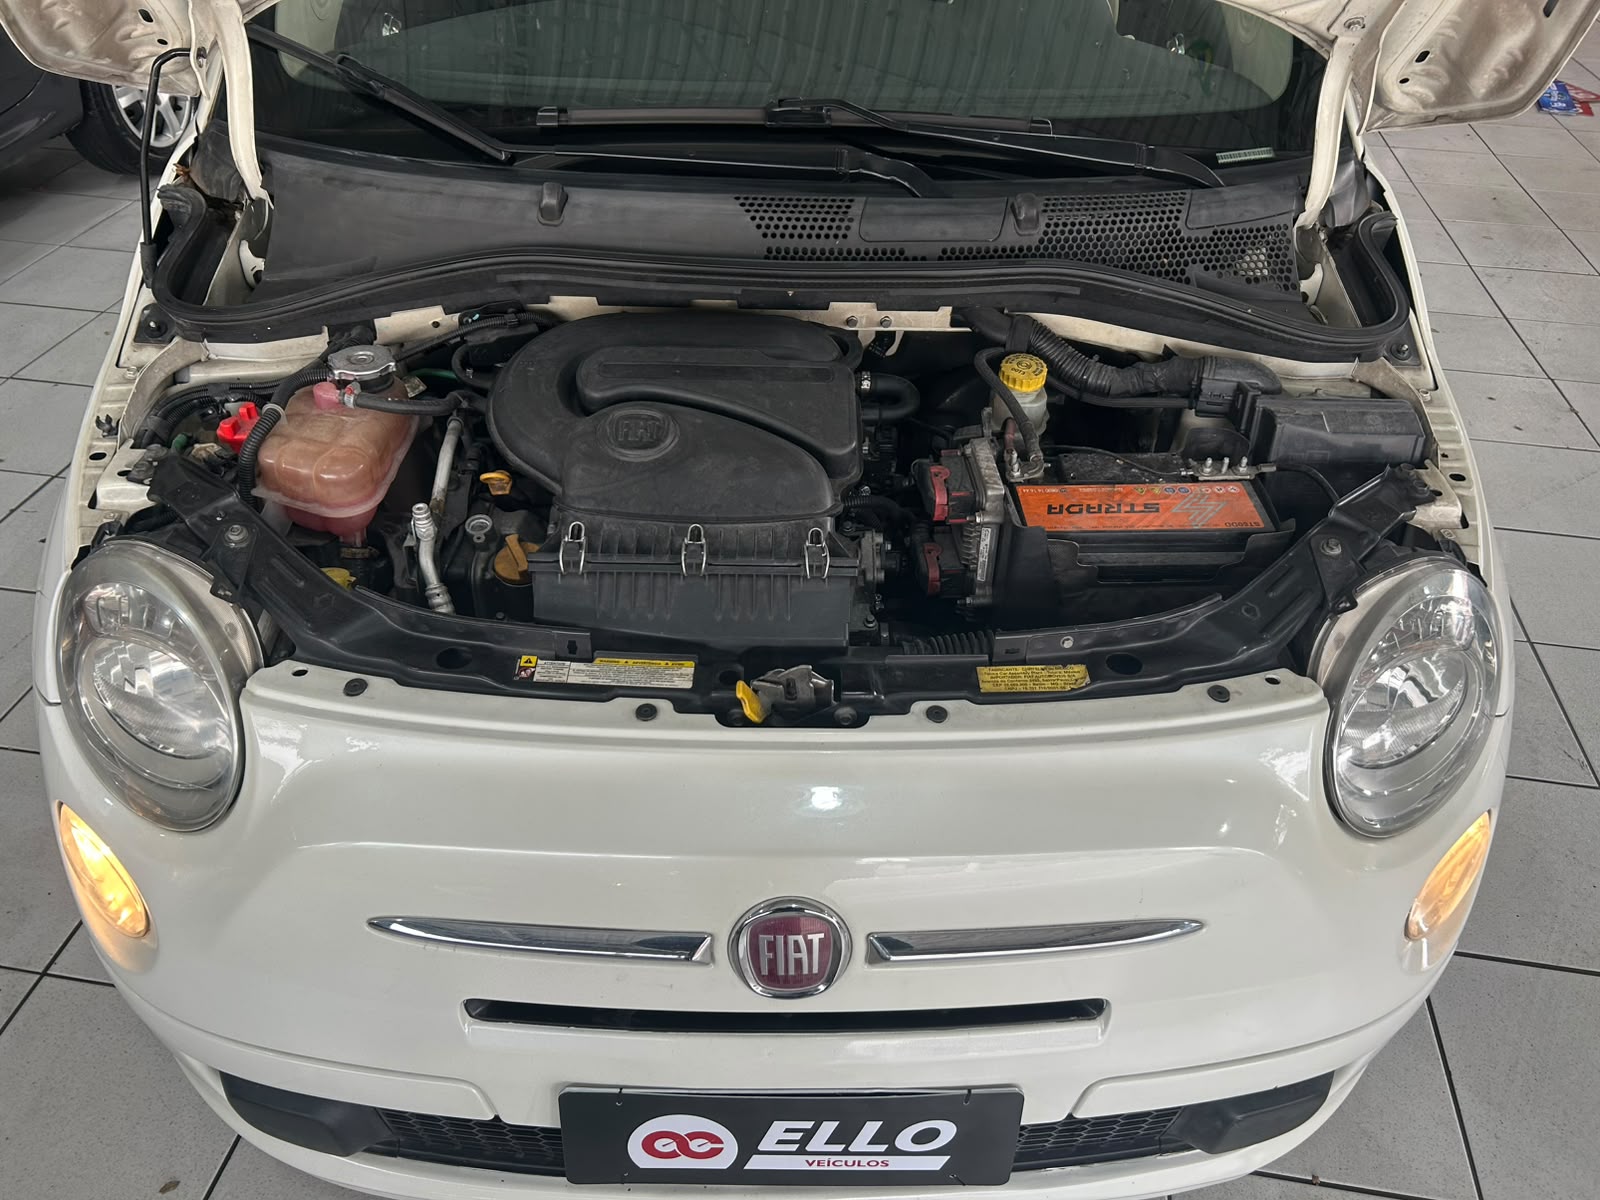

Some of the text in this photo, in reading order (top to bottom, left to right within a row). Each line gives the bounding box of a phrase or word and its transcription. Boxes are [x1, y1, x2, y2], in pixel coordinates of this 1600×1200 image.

[617, 420, 660, 441] FIAT
[1046, 502, 1161, 515] STRADA
[758, 932, 825, 976] FIAT
[757, 1119, 958, 1152] ELLO
[804, 1157, 890, 1168] VEÍCULOS
